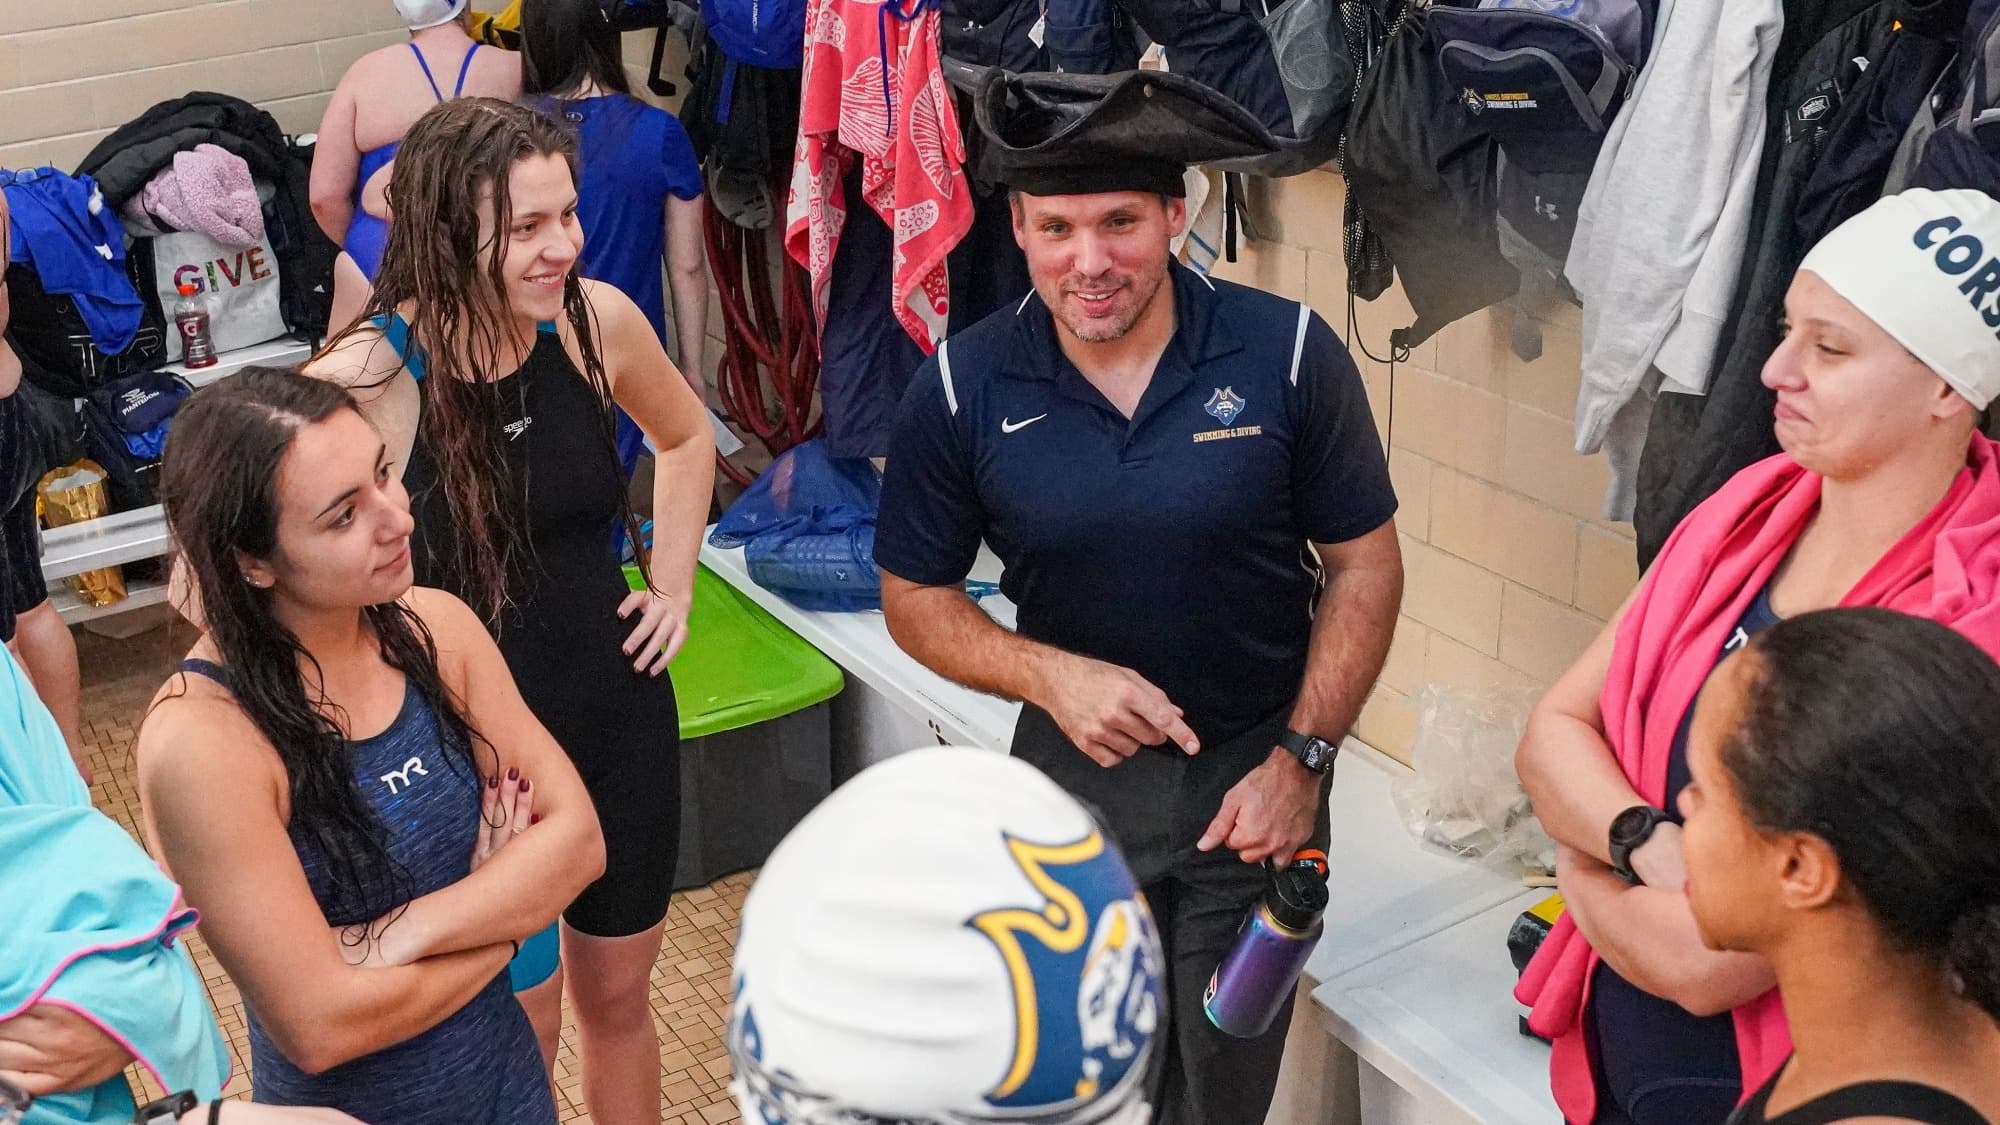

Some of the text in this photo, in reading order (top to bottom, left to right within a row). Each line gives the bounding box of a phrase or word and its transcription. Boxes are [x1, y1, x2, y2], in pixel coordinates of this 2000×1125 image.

[173, 246, 272, 296] GIVE
[1913, 216, 2000, 342] CORS
[67, 326, 165, 378] TR
[1193, 425, 1263, 443] SWIMMING & DIVING
[380, 756, 429, 795] TYR
